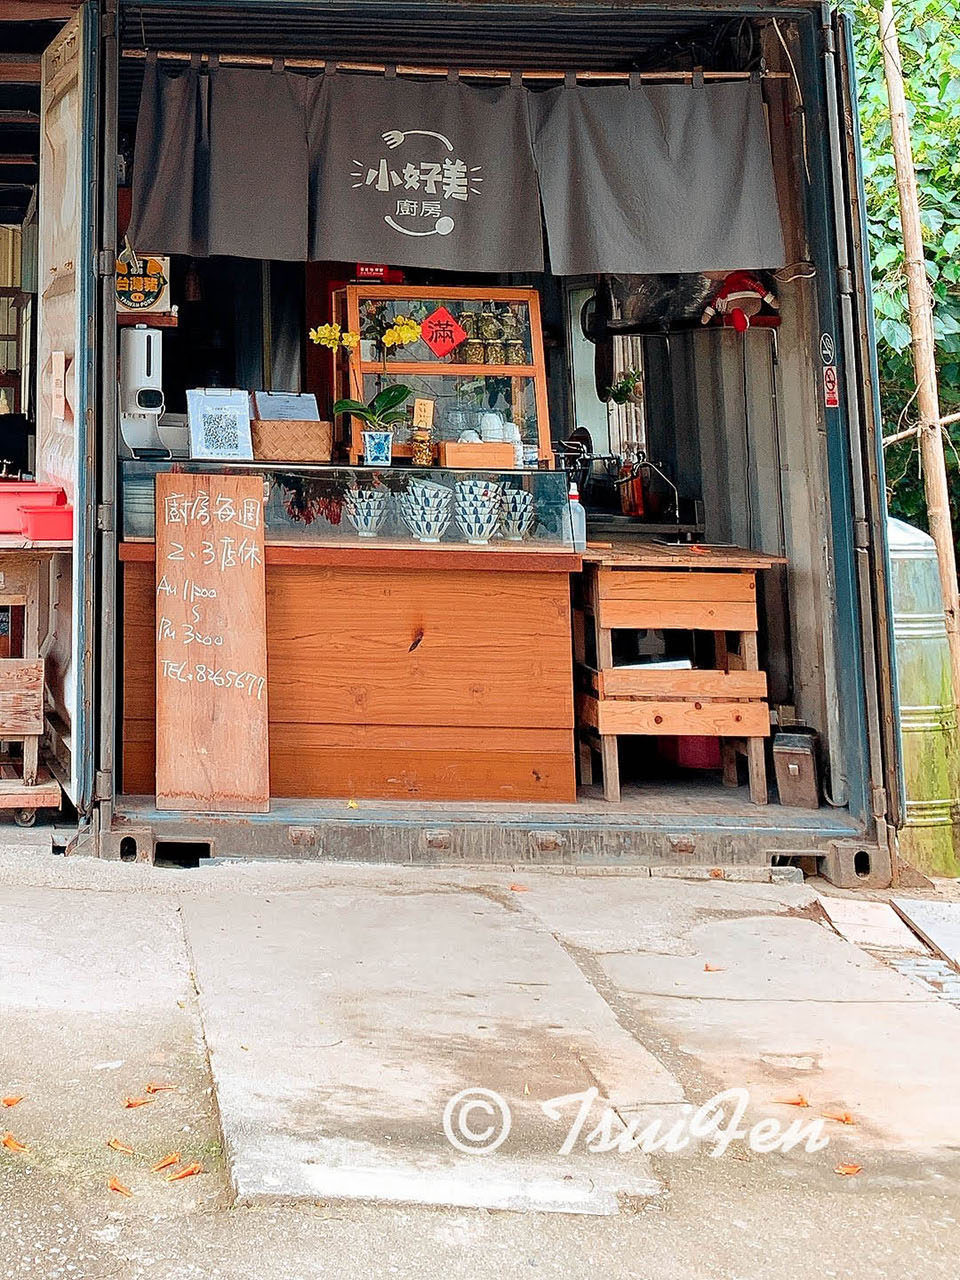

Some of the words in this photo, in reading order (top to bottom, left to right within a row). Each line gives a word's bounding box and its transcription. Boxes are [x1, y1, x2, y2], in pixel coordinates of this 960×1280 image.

[365, 158, 469, 201] 小好美
[395, 199, 442, 218] 廚房
[428, 319, 455, 344] 滿
[164, 490, 261, 532] 廚房每週
